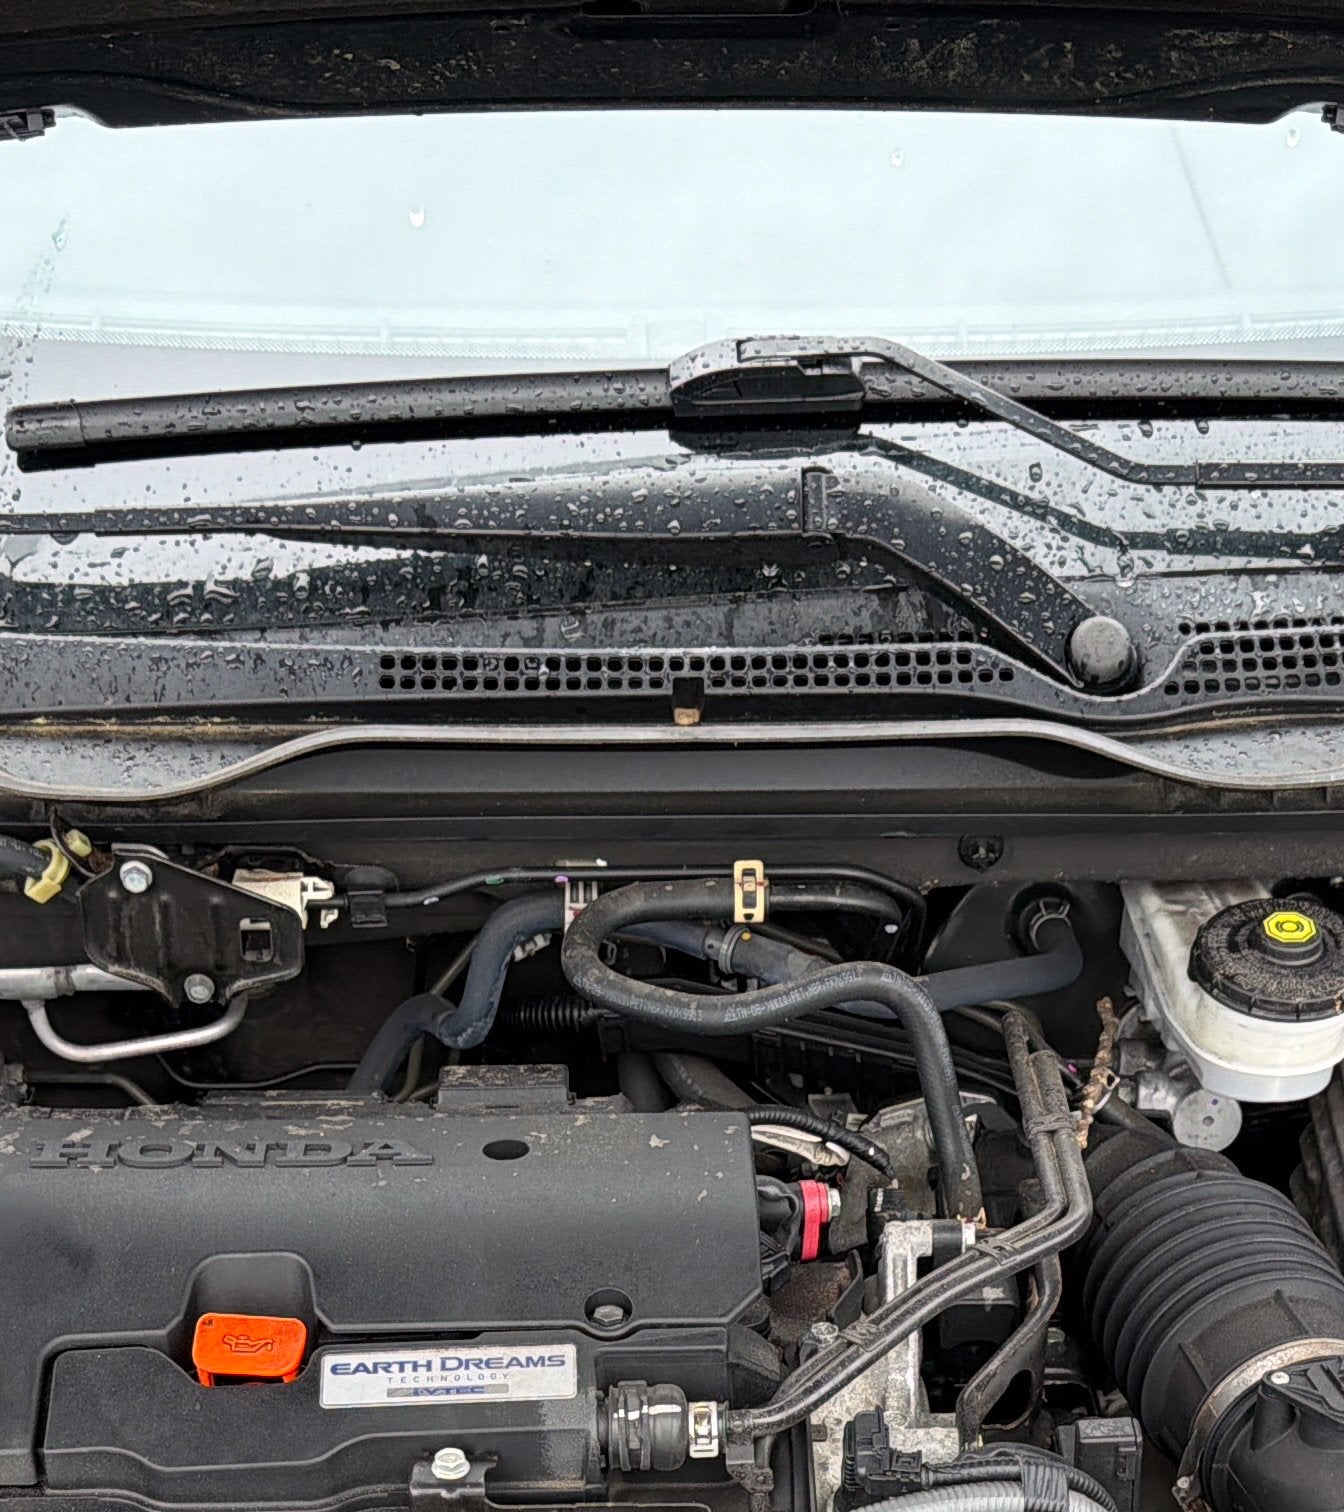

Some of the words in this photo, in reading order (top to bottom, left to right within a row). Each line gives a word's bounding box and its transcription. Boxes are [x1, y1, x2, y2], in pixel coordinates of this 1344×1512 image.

[29, 1139, 434, 1169] HONDA
[329, 1359, 433, 1376] EARTH
[439, 1354, 566, 1373] DREAMS
[387, 1373, 510, 1384] TECHNOLOGY
